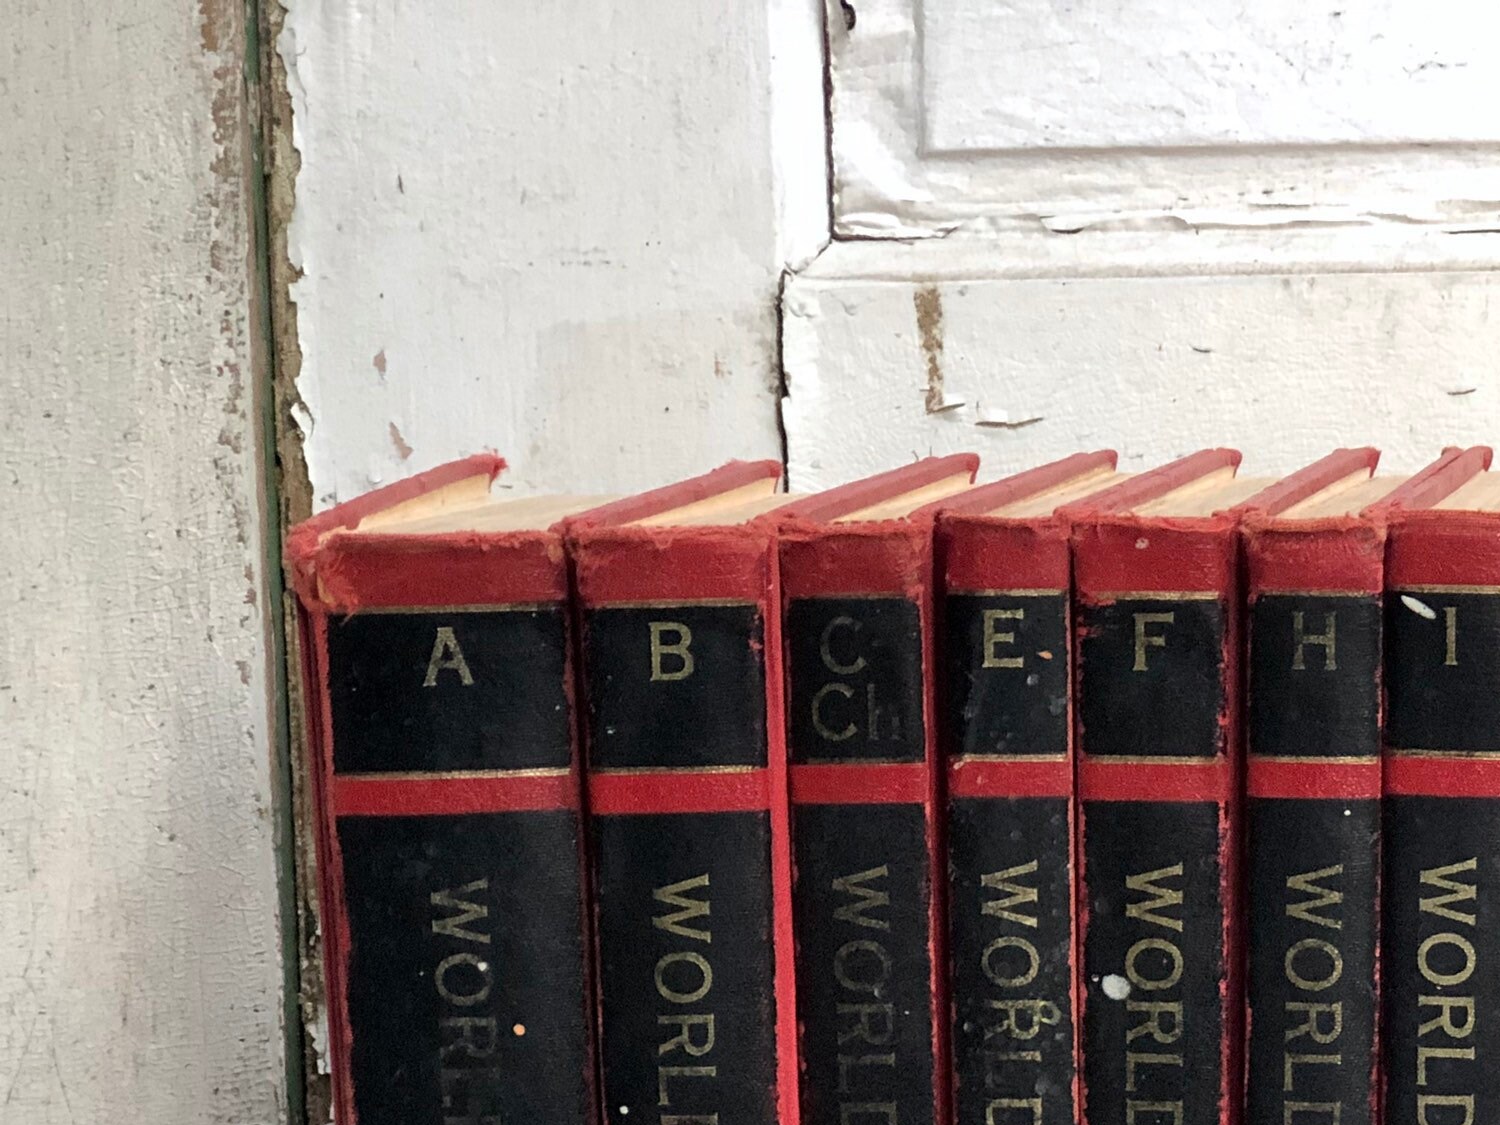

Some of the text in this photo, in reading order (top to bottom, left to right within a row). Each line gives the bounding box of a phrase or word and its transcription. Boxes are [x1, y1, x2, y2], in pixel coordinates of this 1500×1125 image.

[422, 626, 474, 687] A
[648, 621, 695, 682] B
[980, 607, 1026, 669] E
[1131, 611, 1175, 672] F
[1291, 610, 1337, 671] H
[1442, 605, 1459, 666] I
